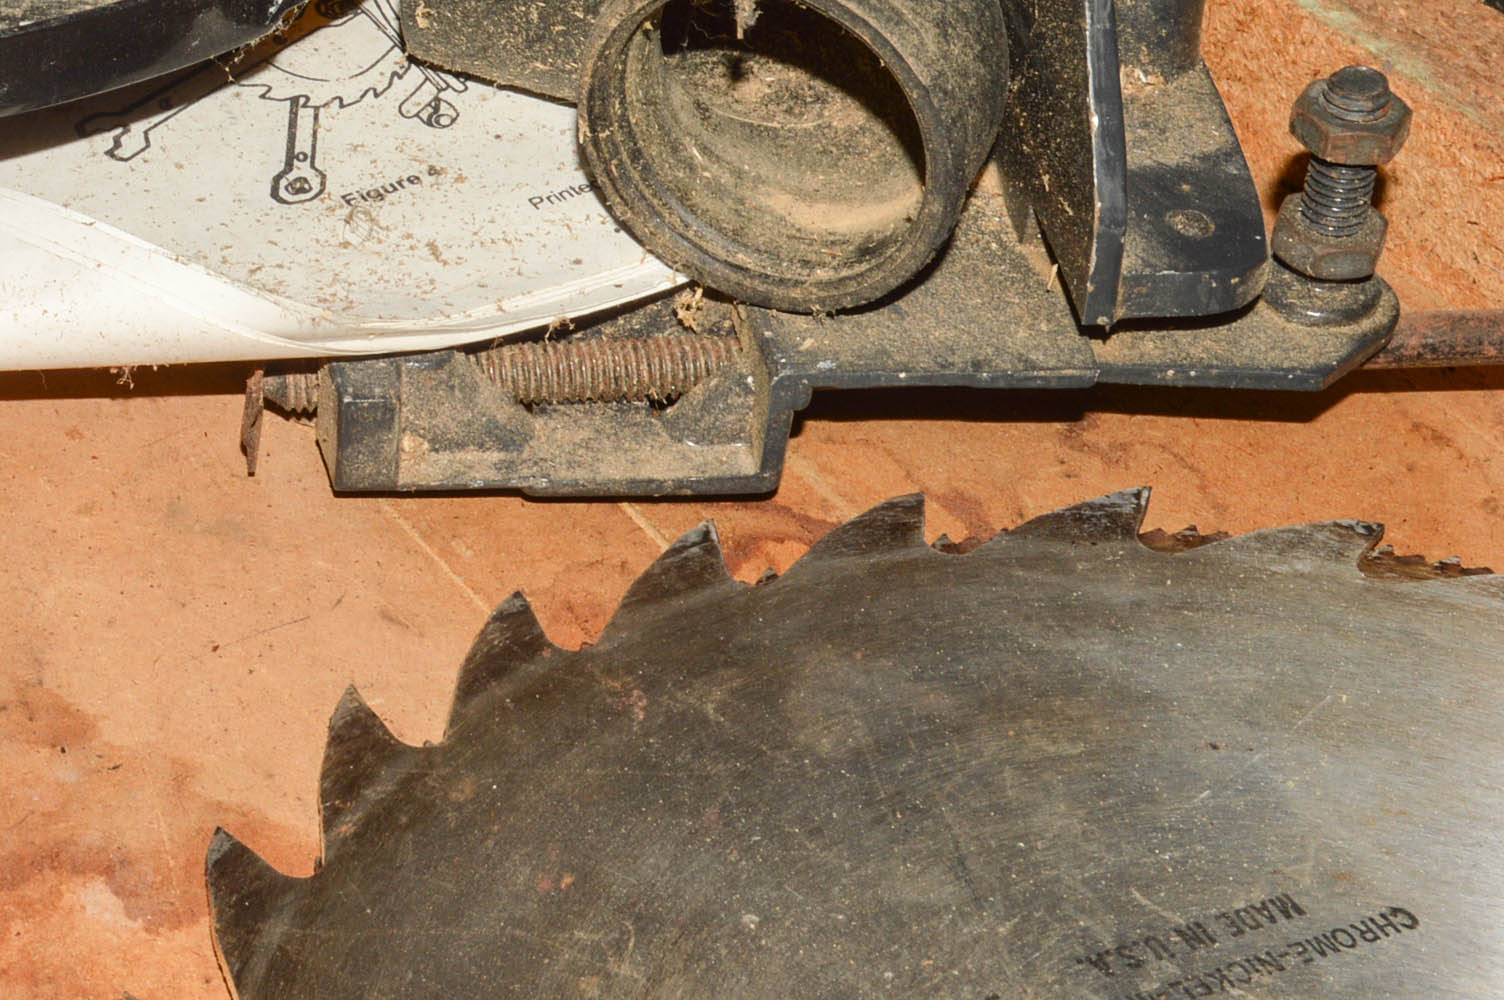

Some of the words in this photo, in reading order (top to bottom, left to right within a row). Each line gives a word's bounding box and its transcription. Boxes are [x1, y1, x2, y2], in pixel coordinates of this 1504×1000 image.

[341, 175, 422, 207] Figure
[1215, 892, 1307, 938] MADE
[1173, 920, 1220, 950] IN
